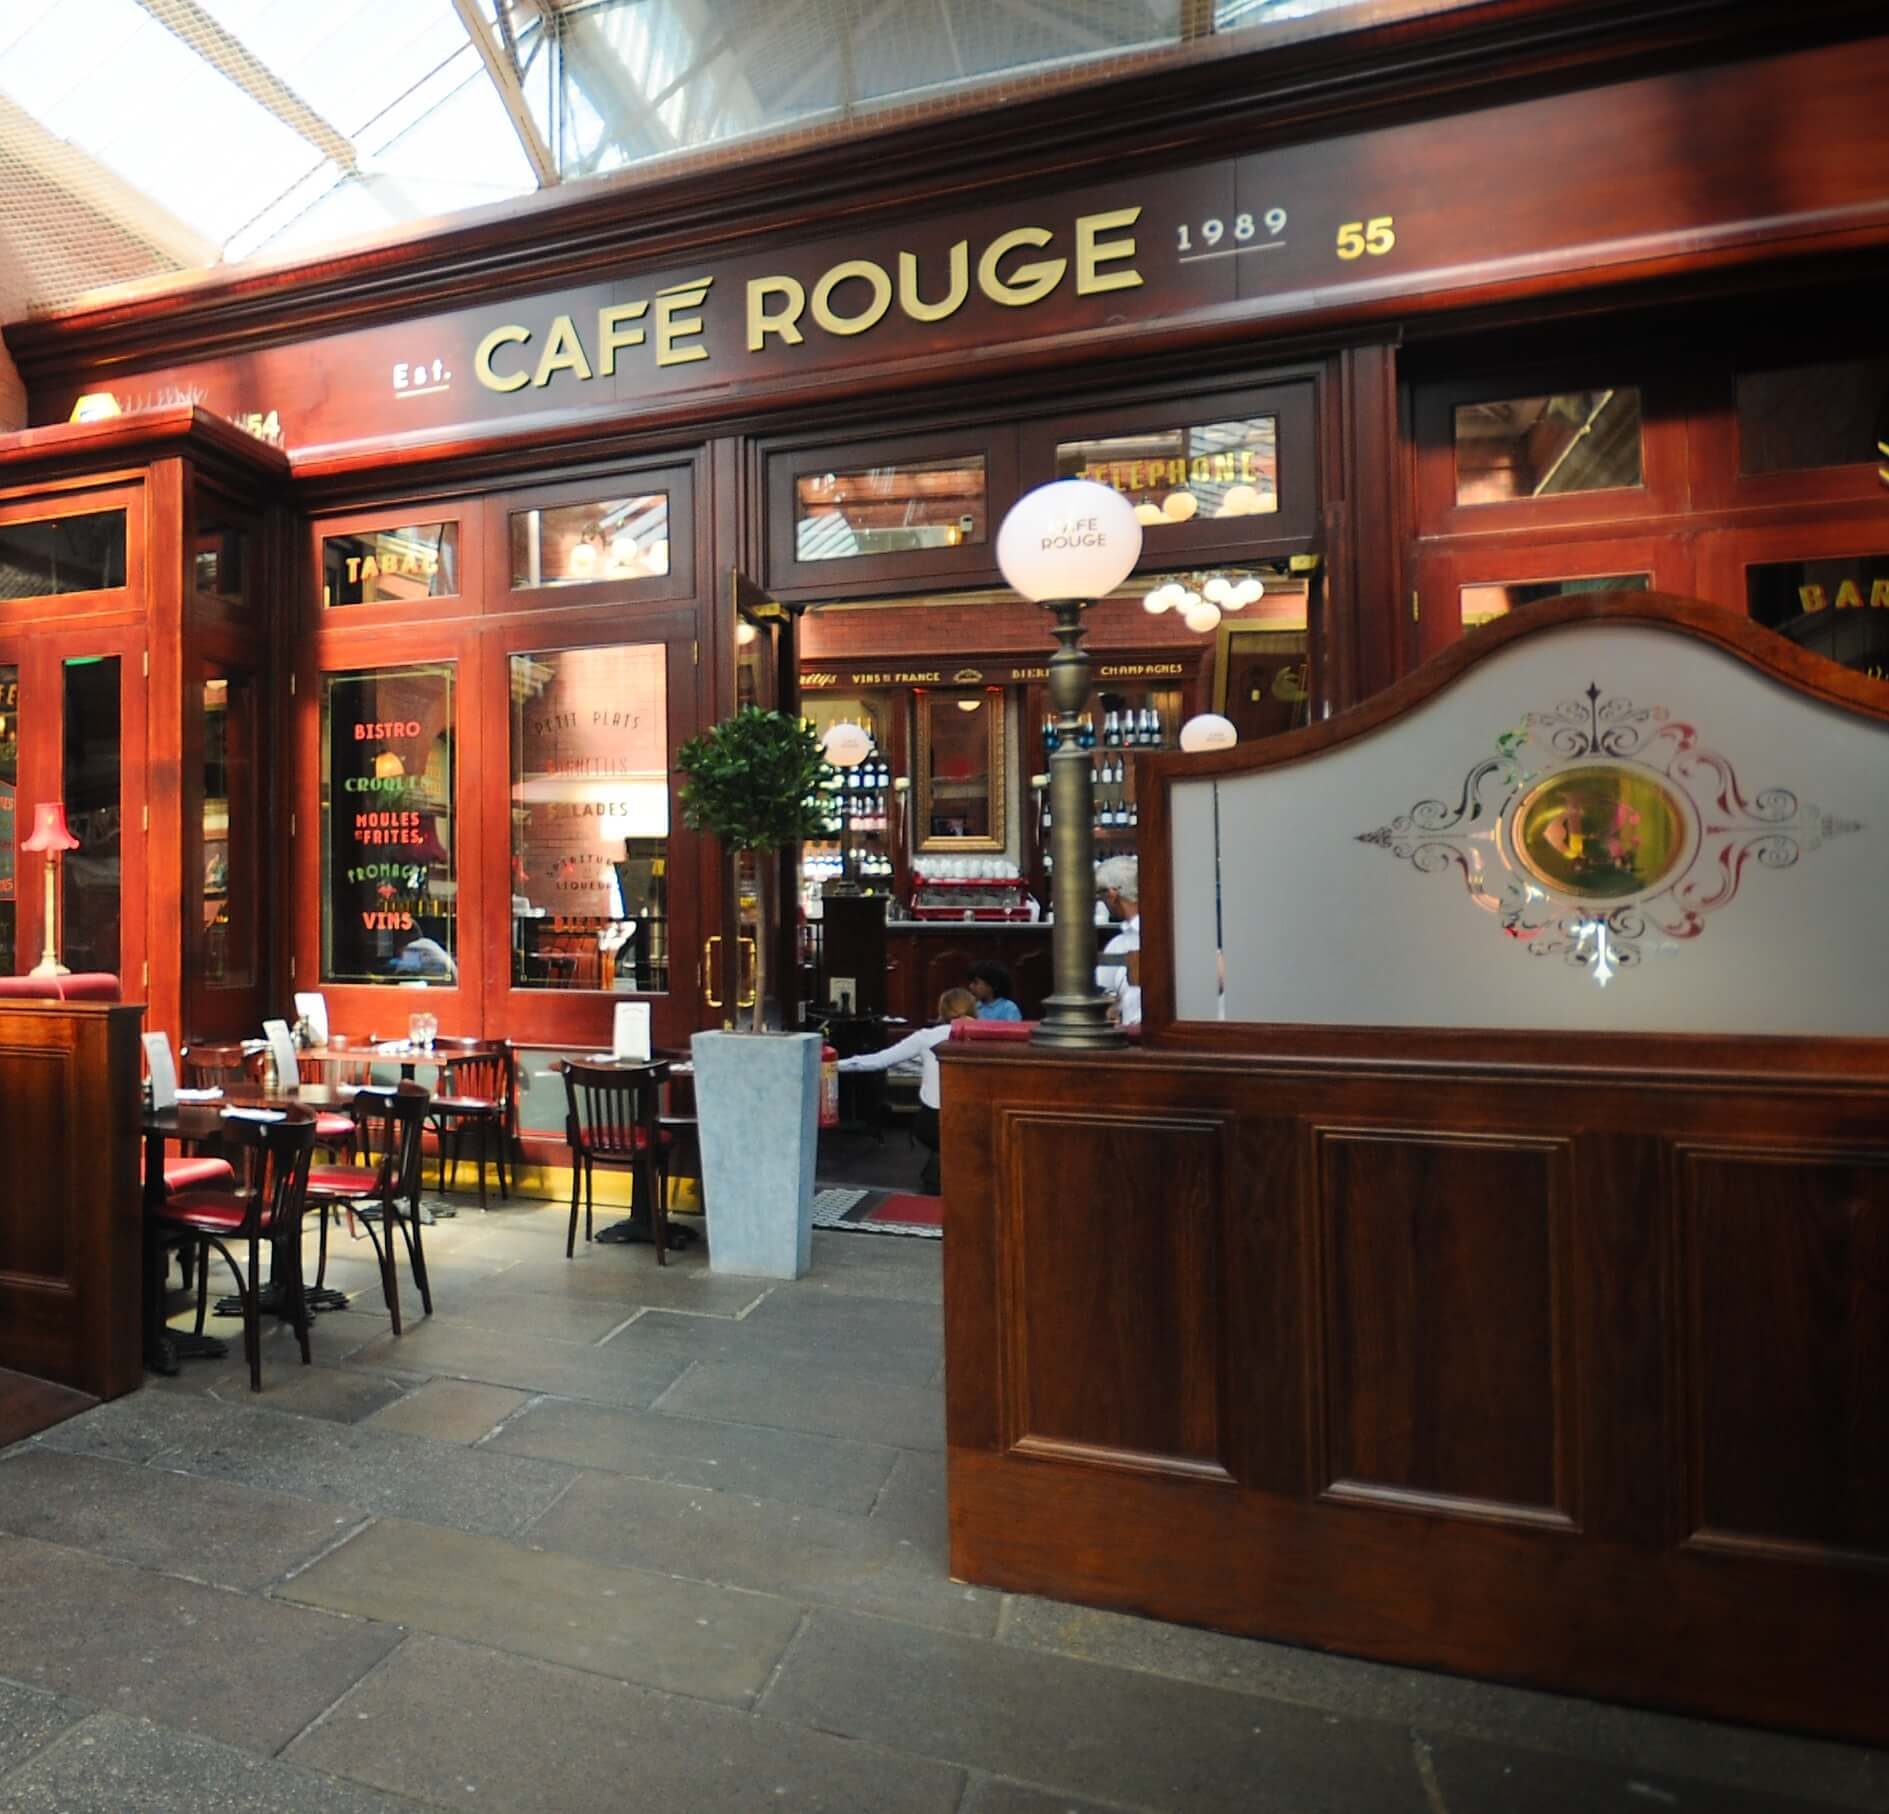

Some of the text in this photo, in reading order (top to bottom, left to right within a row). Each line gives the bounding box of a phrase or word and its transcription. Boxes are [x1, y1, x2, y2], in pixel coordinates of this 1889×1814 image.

[1335, 216, 1396, 261] 55
[393, 206, 1289, 393] Est. CAFÉ ROUGE 1989
[246, 410, 282, 440] 54
[852, 674, 881, 684] VINS
[895, 672, 941, 682] FRANCE
[1012, 668, 1050, 679] BIER
[1100, 663, 1183, 676] CHAMPAGNES
[593, 711, 640, 728] PLATS
[354, 721, 421, 740] BISTRO
[550, 803, 628, 818] SLADES
[355, 811, 420, 828] MOULES
[362, 911, 412, 931] VINS
